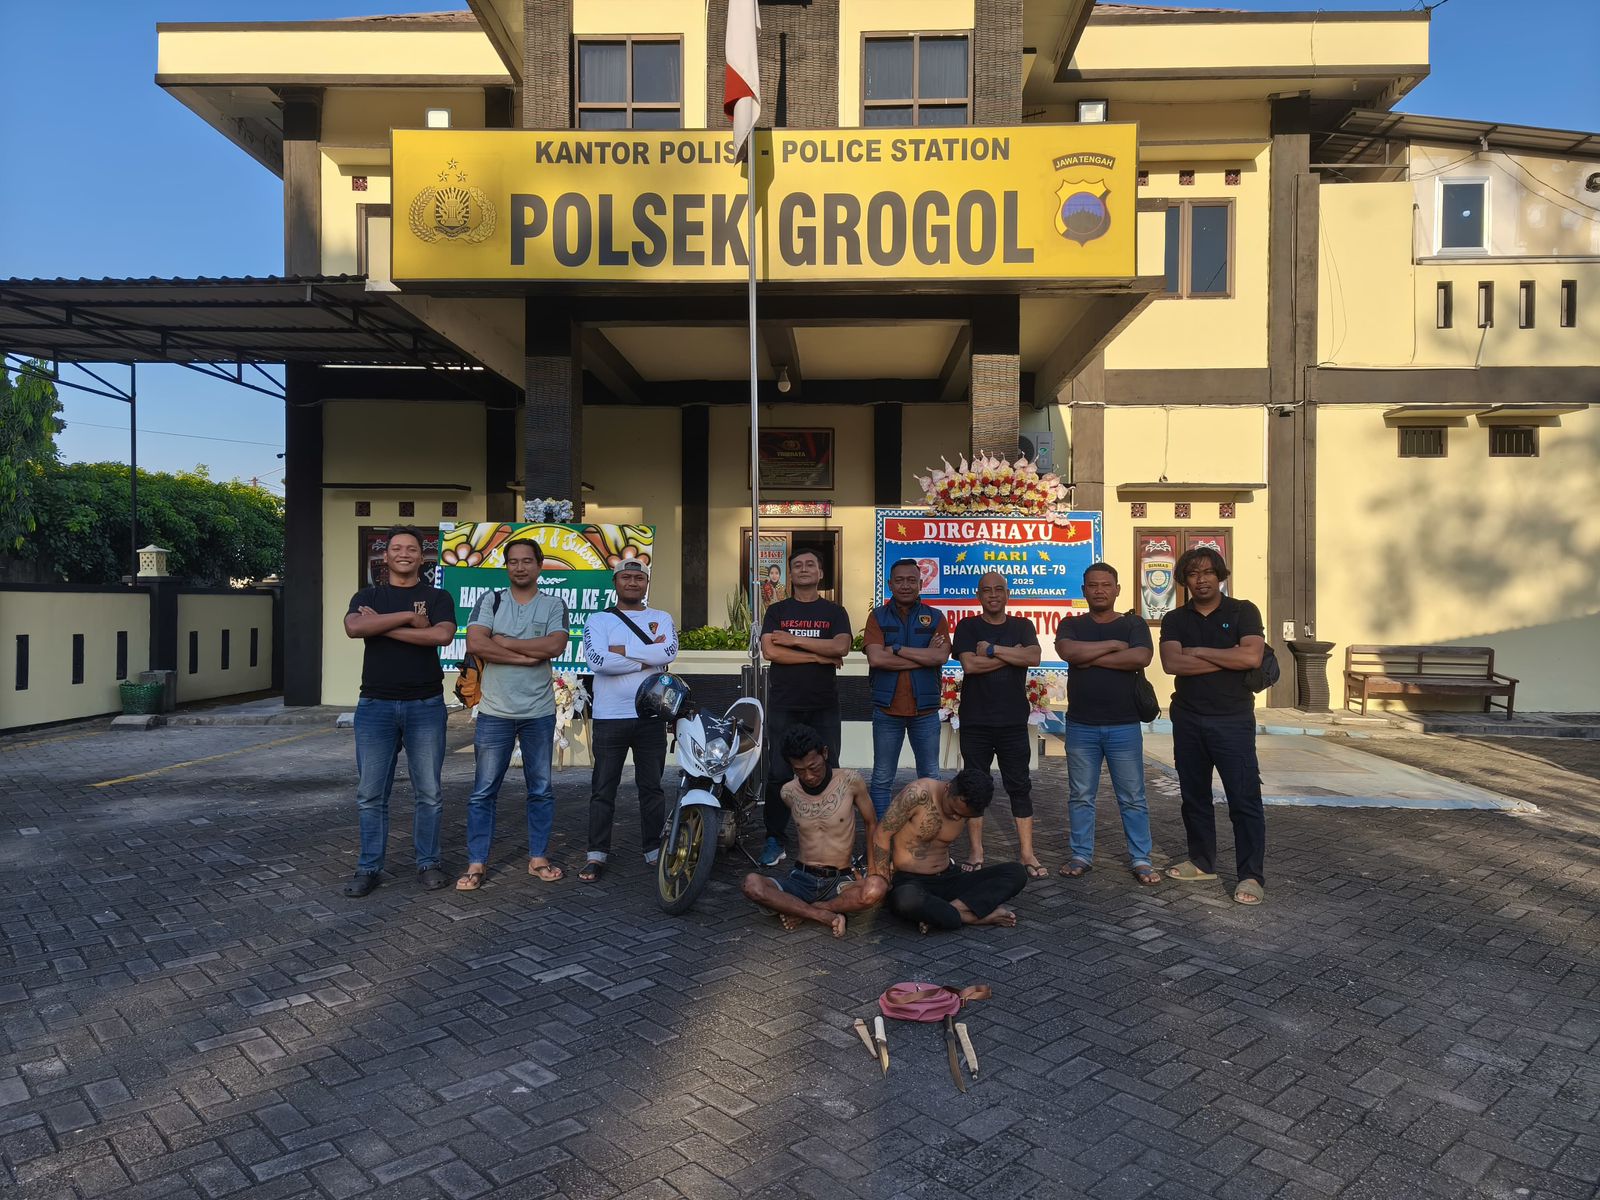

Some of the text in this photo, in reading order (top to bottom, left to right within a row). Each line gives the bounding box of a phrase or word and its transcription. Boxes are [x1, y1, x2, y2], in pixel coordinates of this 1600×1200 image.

[536, 141, 650, 164] KANTOR
[660, 141, 748, 164] POLIS
[782, 140, 882, 163] POLICE
[891, 137, 1010, 162] STATION
[1056, 155, 1113, 168] JAWA TENGAH
[510, 190, 1034, 267] POLSEK GROGOL
[924, 523, 1053, 540] DIRGAHAYU
[984, 551, 1027, 561] HARI
[944, 564, 1028, 575] BHAYANGKARA
[780, 620, 831, 629] BERSATU KITA
[789, 629, 820, 637] TEGUH
